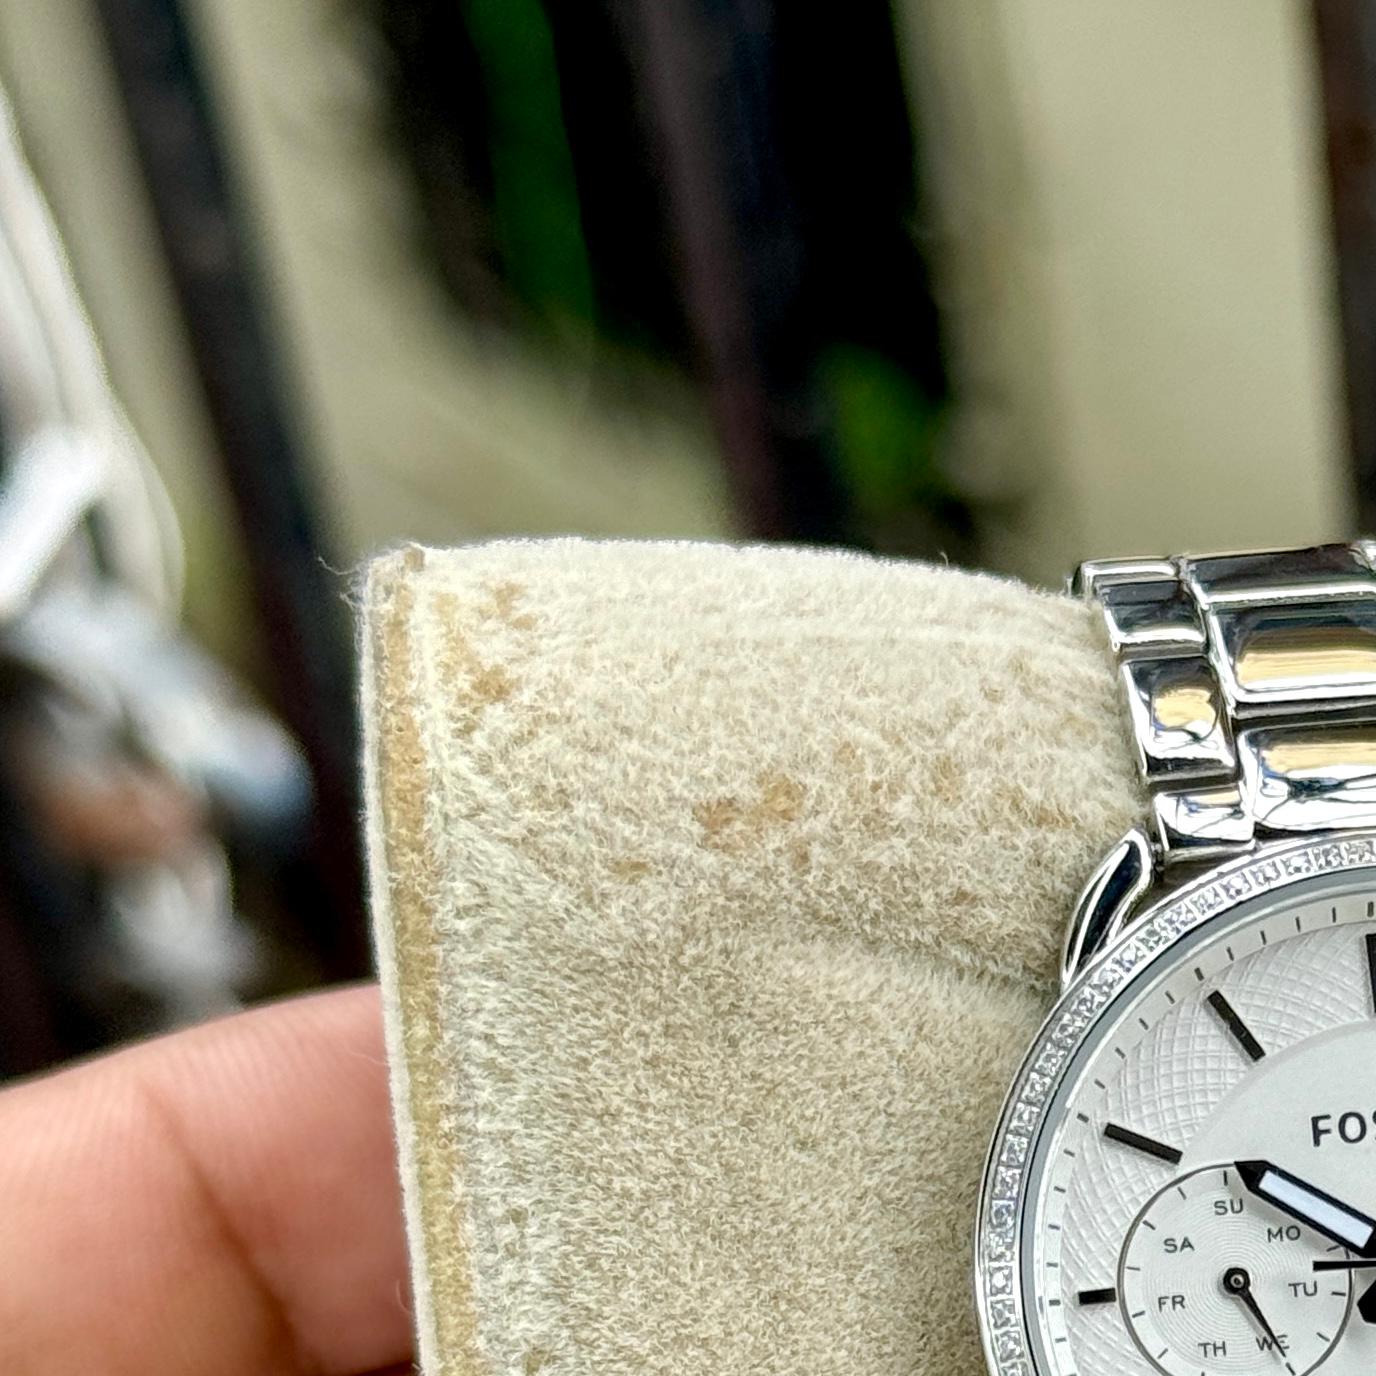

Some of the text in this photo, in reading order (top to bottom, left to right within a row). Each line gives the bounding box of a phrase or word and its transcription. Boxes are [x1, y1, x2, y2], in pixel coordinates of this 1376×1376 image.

[1213, 1198, 1244, 1216] SU
[1267, 1225, 1301, 1243] MO
[1163, 1236, 1195, 1253] SA
[1288, 1281, 1318, 1298] TU
[1157, 1294, 1186, 1313] FR
[1197, 1341, 1227, 1358] TH
